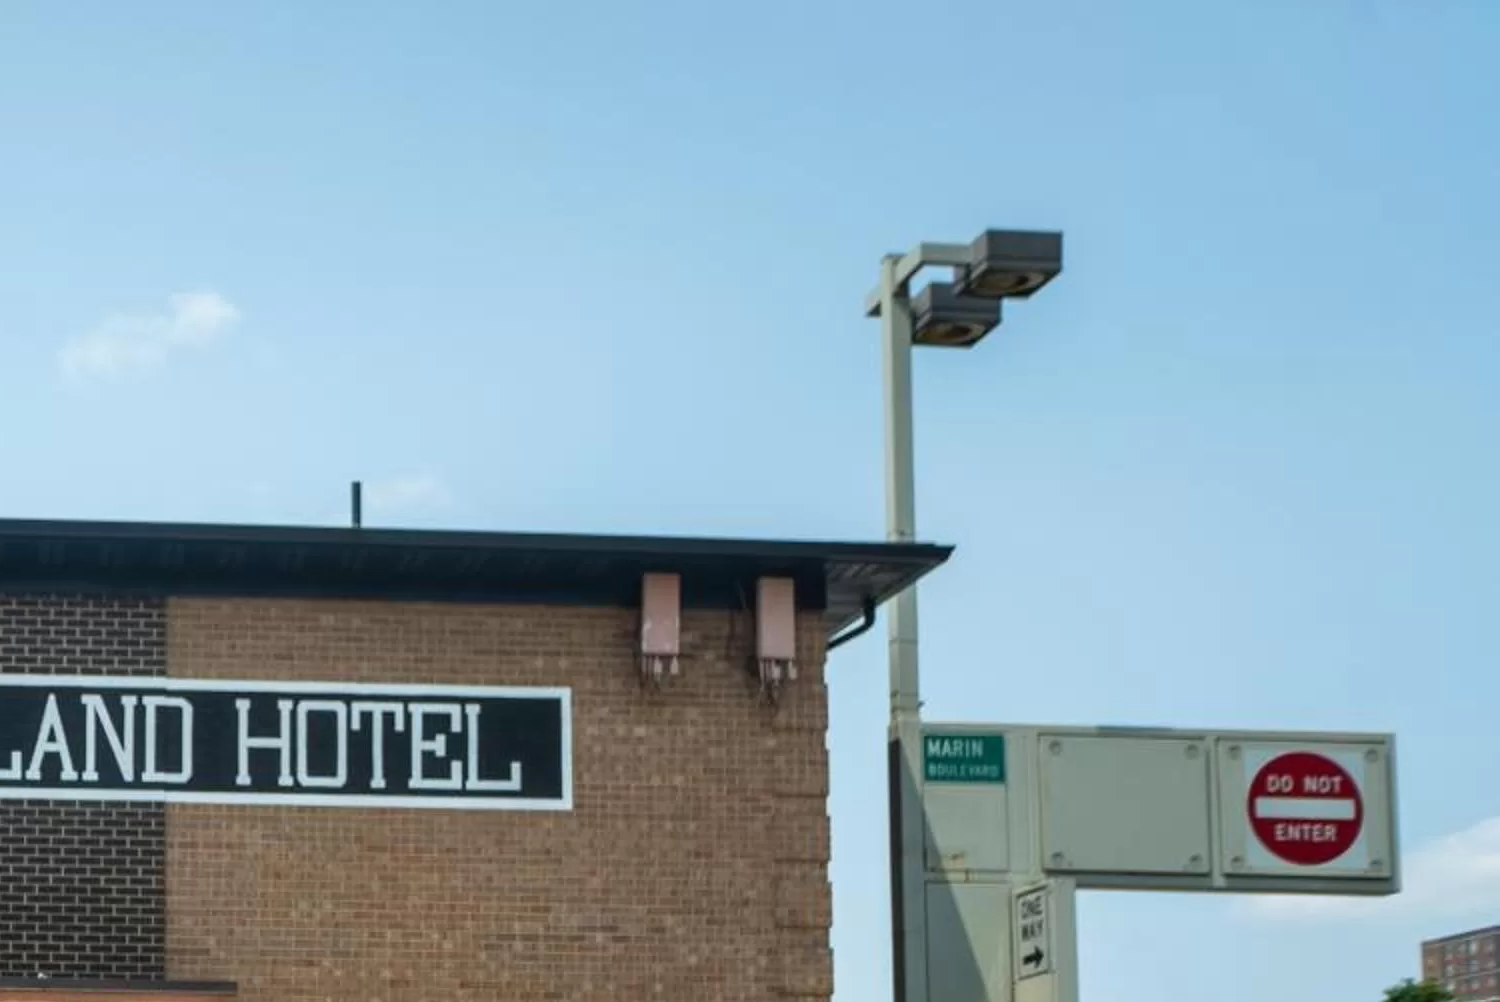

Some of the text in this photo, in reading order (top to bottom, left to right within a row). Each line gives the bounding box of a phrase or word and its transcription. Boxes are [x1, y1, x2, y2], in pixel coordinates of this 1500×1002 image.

[236, 699, 522, 791] HOTEL
[927, 738, 984, 758] MARIN
[928, 763, 1000, 778] BOULEVARD
[1266, 774, 1342, 793] DO NOT
[1275, 824, 1338, 842] ENTER
